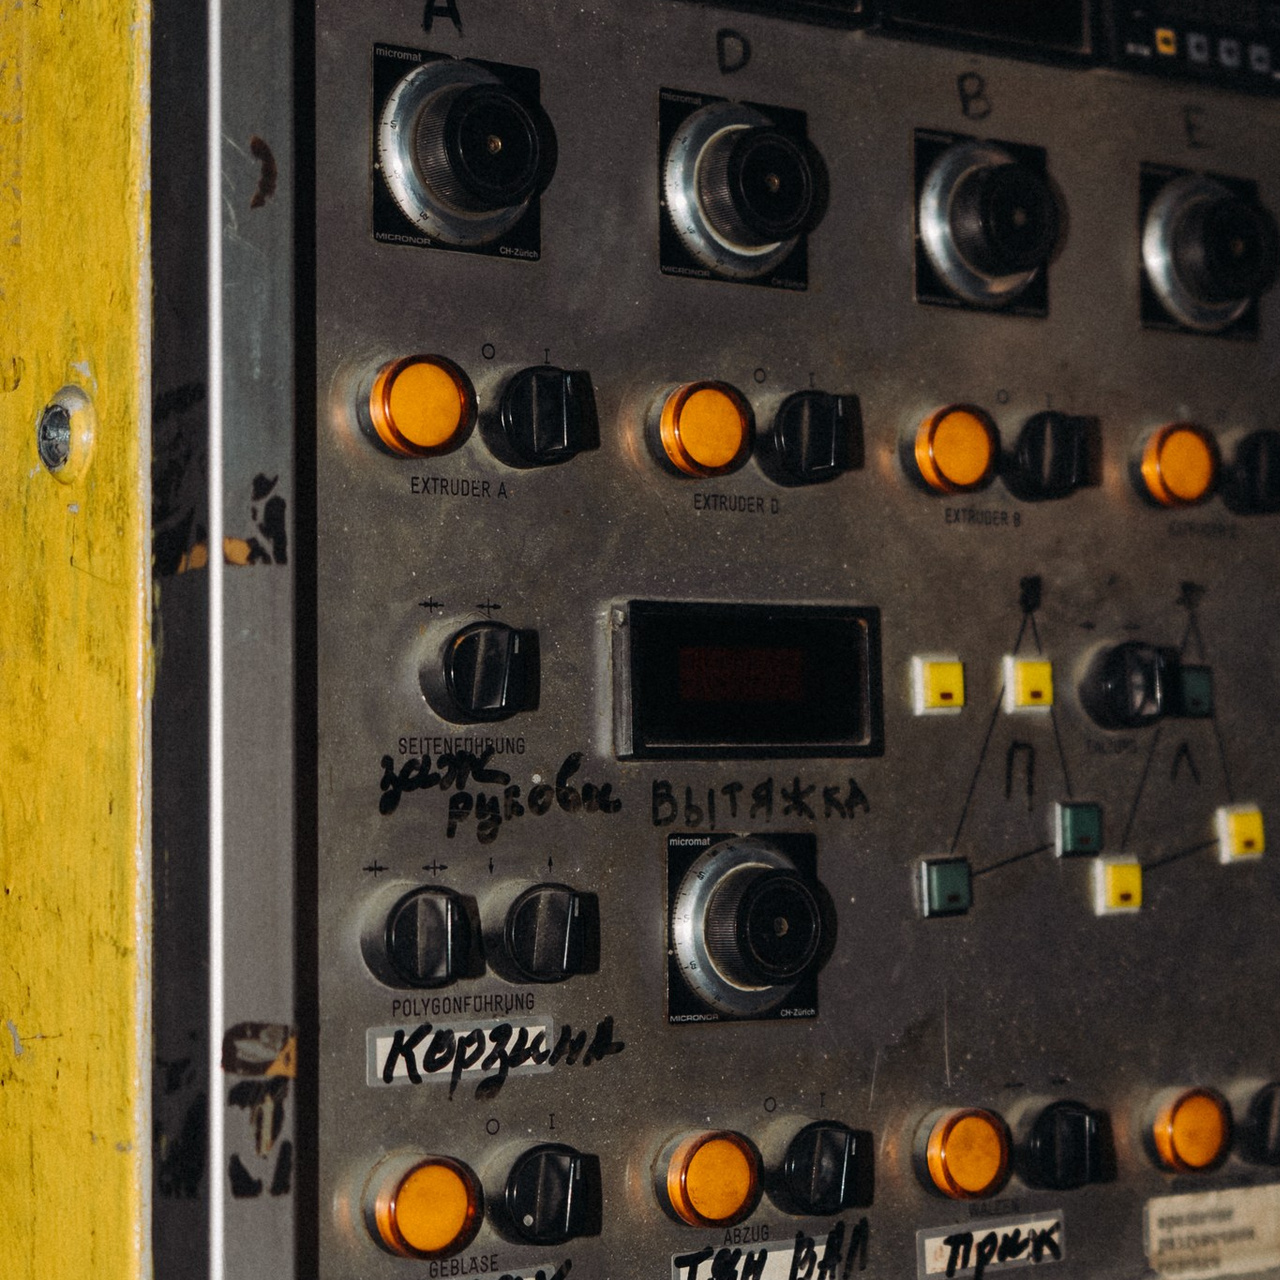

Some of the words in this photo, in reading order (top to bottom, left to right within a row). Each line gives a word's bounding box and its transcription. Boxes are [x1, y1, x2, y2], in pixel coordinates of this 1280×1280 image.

[375, 46, 422, 63] micromat
[715, 27, 752, 74] D
[957, 71, 993, 120] B
[375, 231, 431, 246] MICRONOR
[499, 245, 539, 260] CH-Zürich
[411, 476, 491, 498] EXTRUDER
[497, 481, 508, 500] A
[694, 492, 765, 514] EXTRUDER
[771, 498, 780, 515] D
[944, 507, 1009, 527] EXTRUDER
[652, 776, 871, 831] ВЫТЯЖКА
[669, 836, 711, 847] micromat
[392, 992, 535, 1018] POLYGONFÜHRUNG
[780, 1007, 816, 1018] CH-Zürich
[669, 1013, 719, 1023] MICRONOR
[723, 1223, 770, 1246] ABZUG
